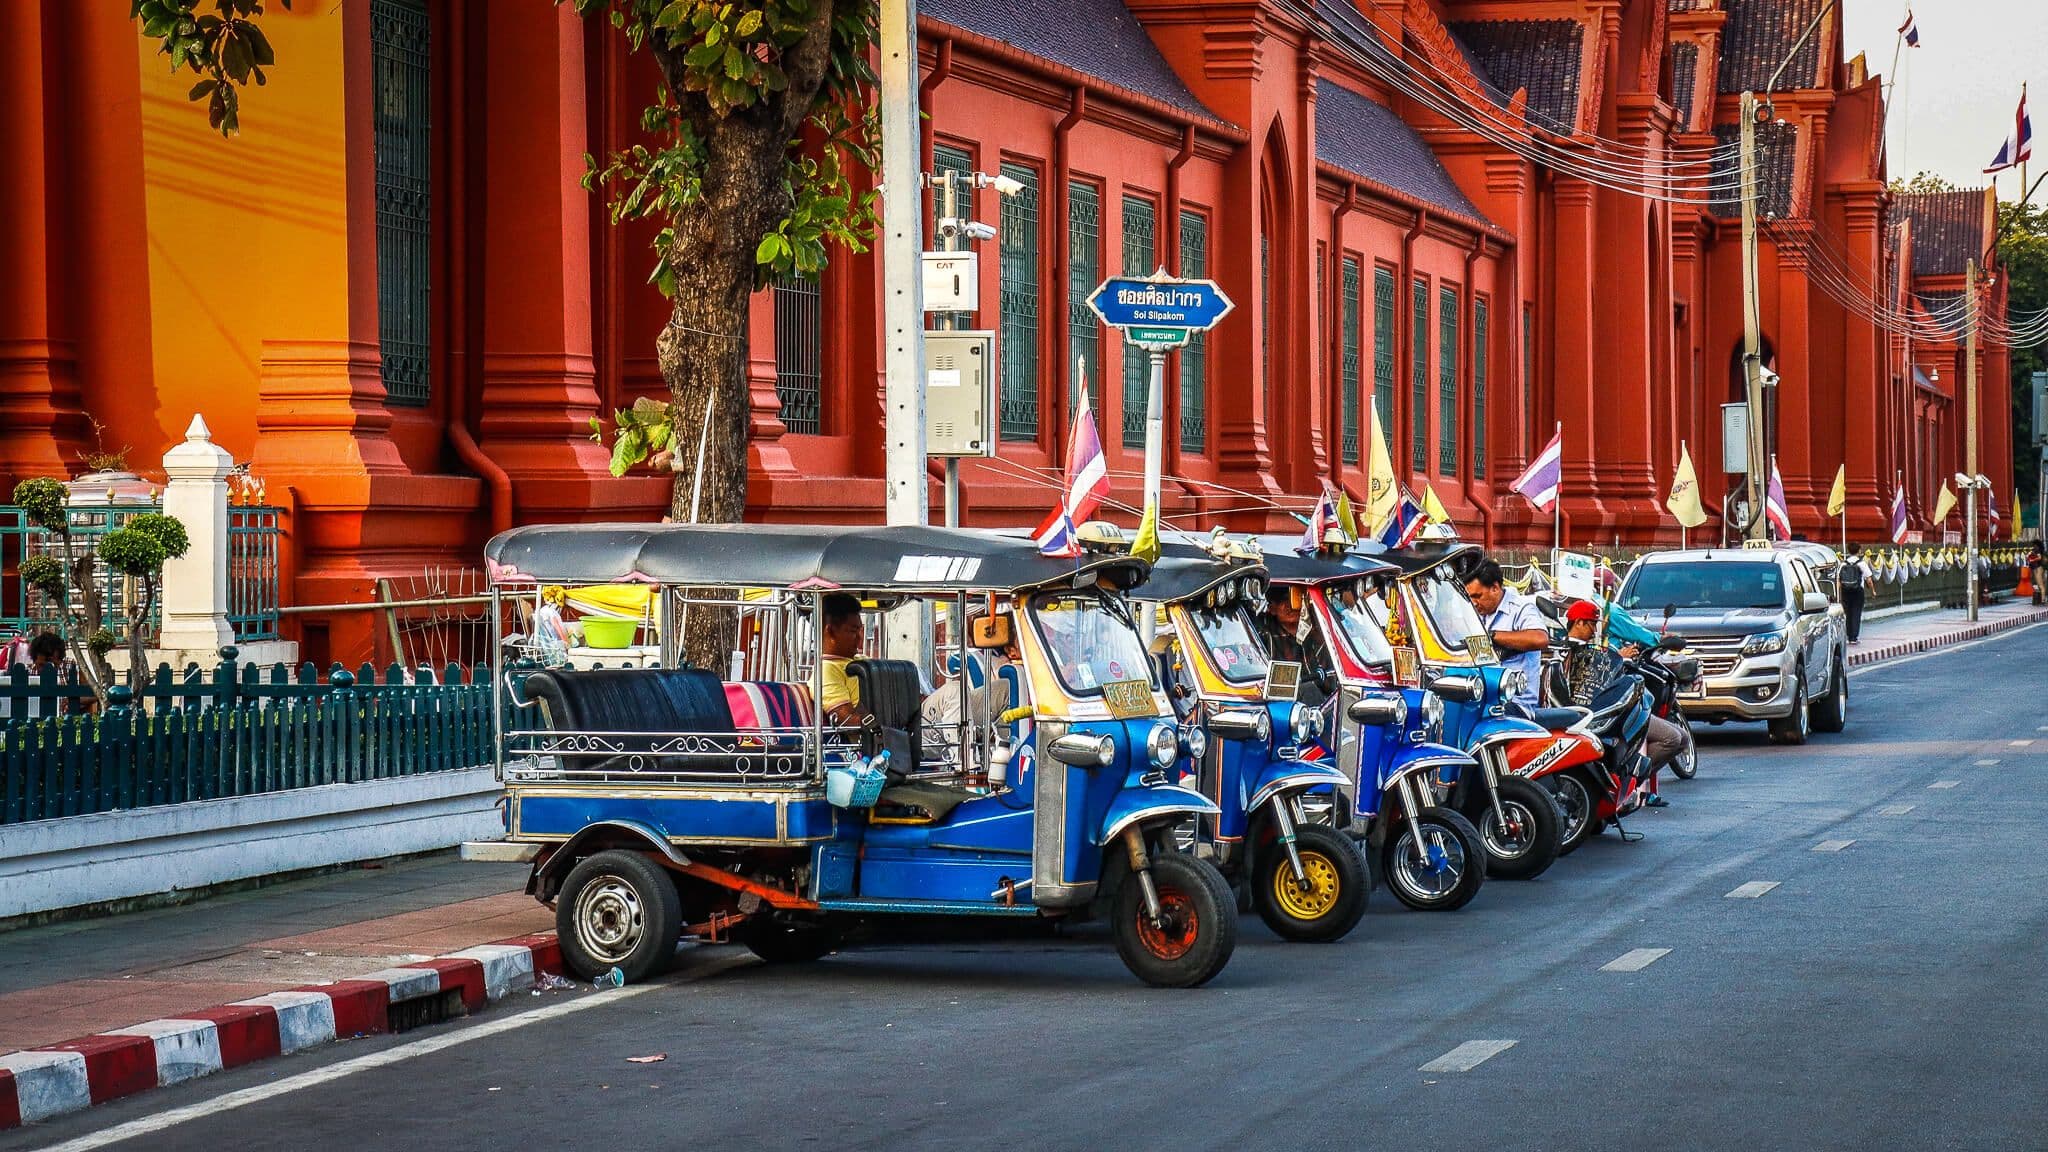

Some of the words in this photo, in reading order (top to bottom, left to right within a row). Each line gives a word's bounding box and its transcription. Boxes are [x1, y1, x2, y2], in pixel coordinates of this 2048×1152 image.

[1118, 285, 1202, 307] ซอยศิลปากร
[1134, 310, 1146, 319] Soi
[1148, 311, 1185, 321] Silpakorn
[1746, 541, 1767, 549] TAXI
